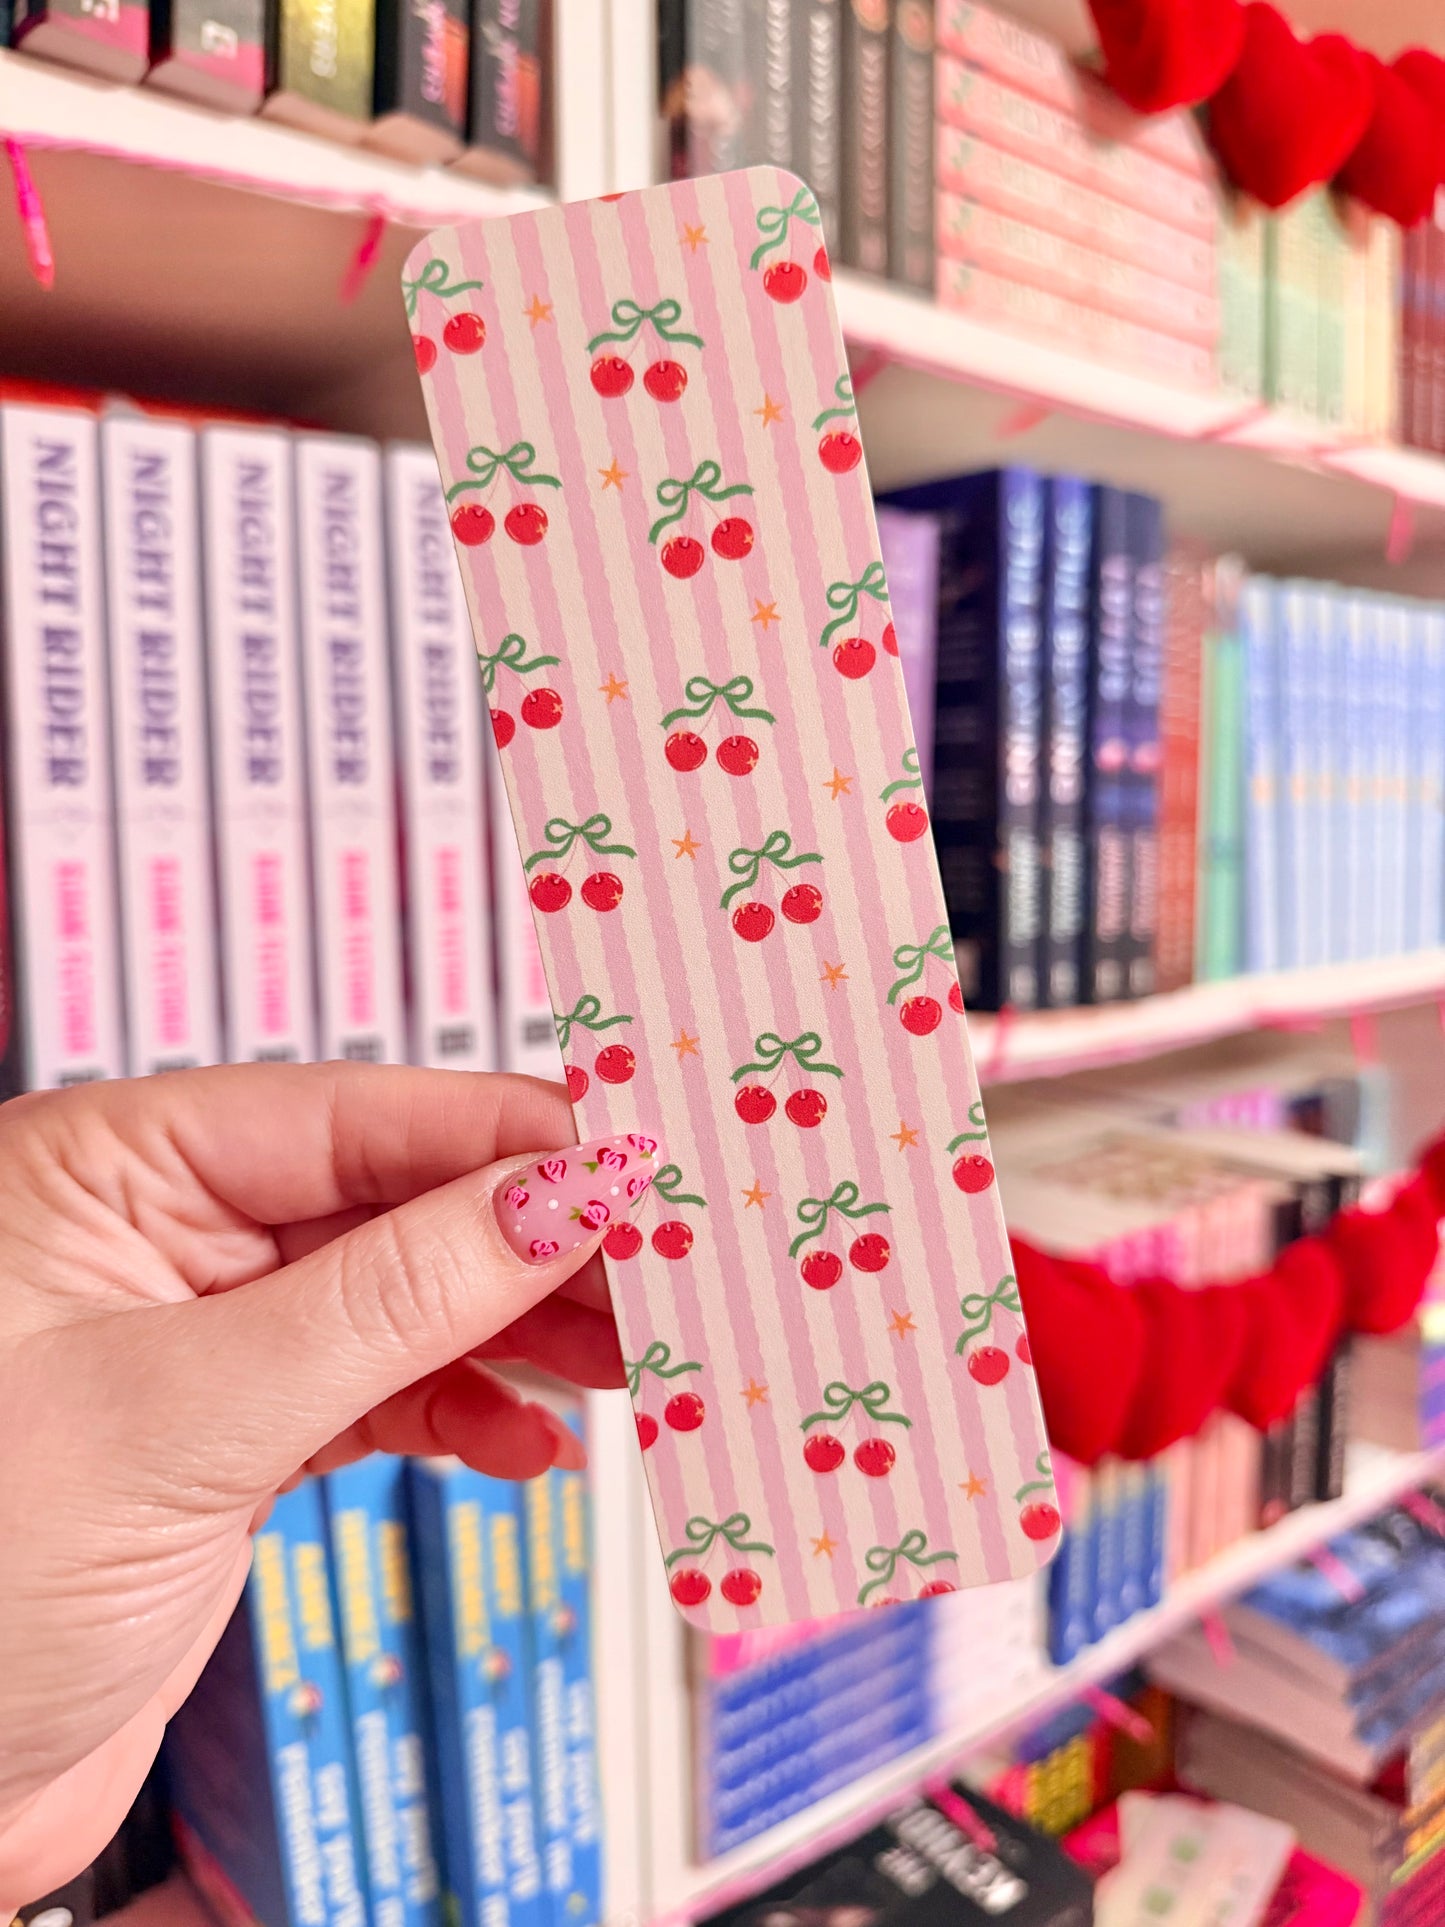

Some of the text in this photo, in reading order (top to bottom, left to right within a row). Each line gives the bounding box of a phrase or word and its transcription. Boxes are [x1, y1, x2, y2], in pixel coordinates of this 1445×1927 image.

[34, 439, 85, 788] NIGHT RIDER
[130, 452, 181, 789] NIGHT RIDER
[235, 459, 283, 786] NIGHT RIDER
[323, 469, 370, 787] NIGHT RIDER
[414, 480, 461, 786] NIGHT RIDER
